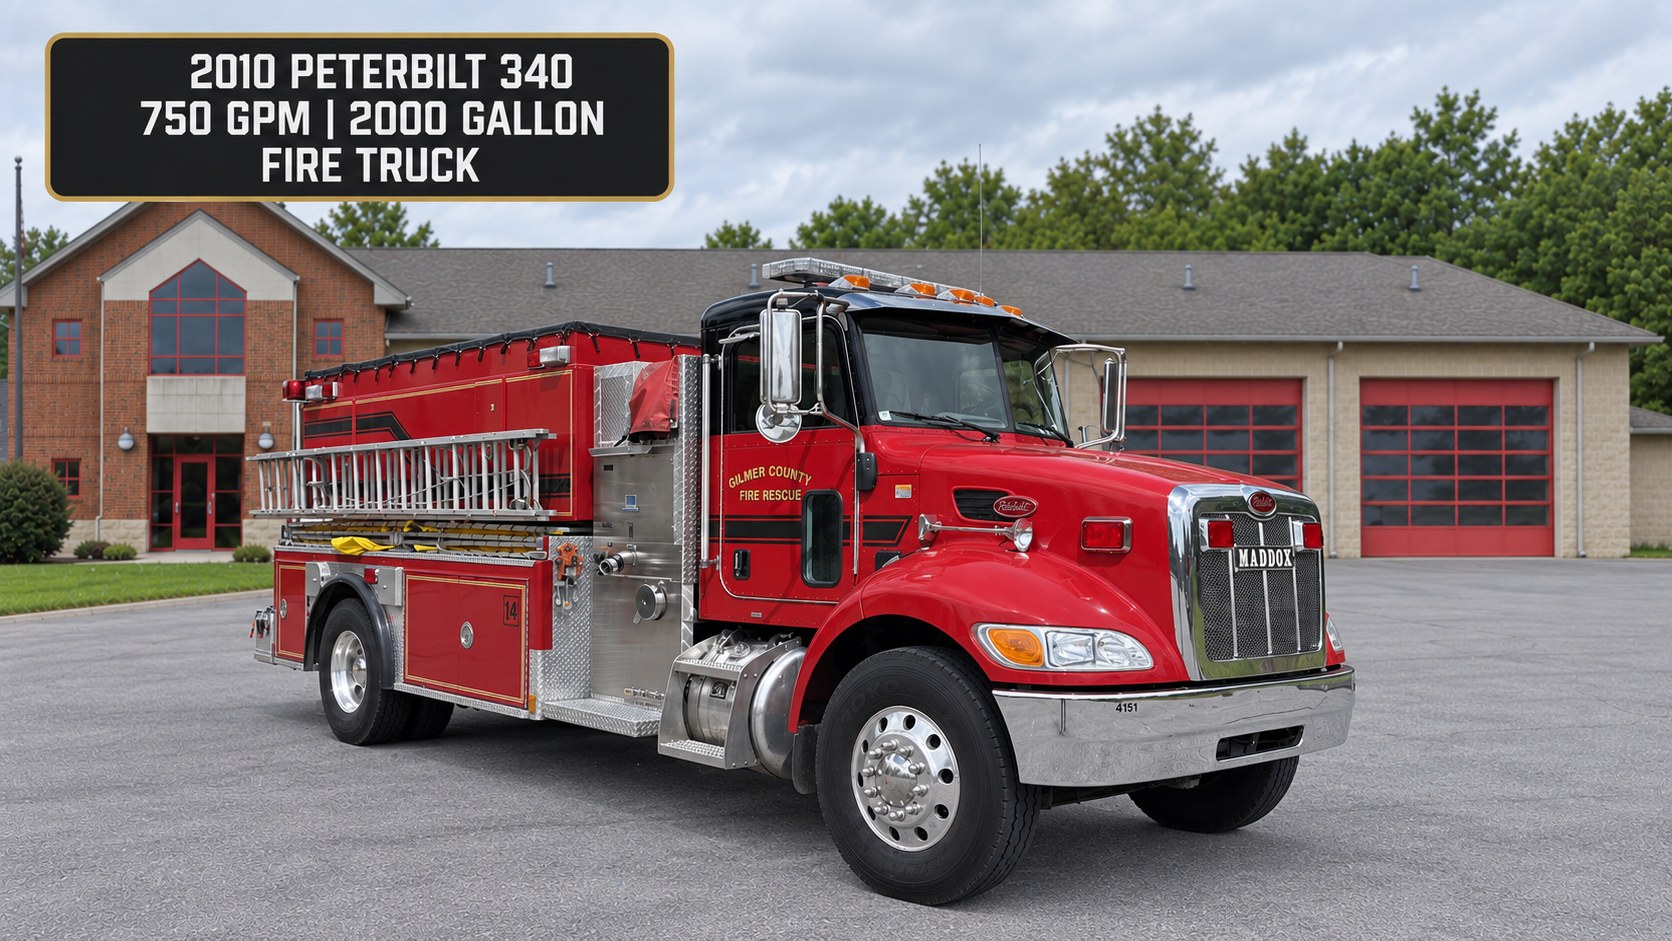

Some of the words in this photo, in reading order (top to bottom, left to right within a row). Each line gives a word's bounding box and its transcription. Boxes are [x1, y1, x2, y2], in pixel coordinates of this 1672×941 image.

[728, 466, 766, 489] GILMER
[768, 465, 812, 486] COUNTY
[739, 490, 760, 501] FIRE
[762, 489, 802, 501] RESCUE
[1238, 548, 1293, 567] MADDOX
[504, 600, 518, 621] 14
[1115, 702, 1138, 713] 4151
